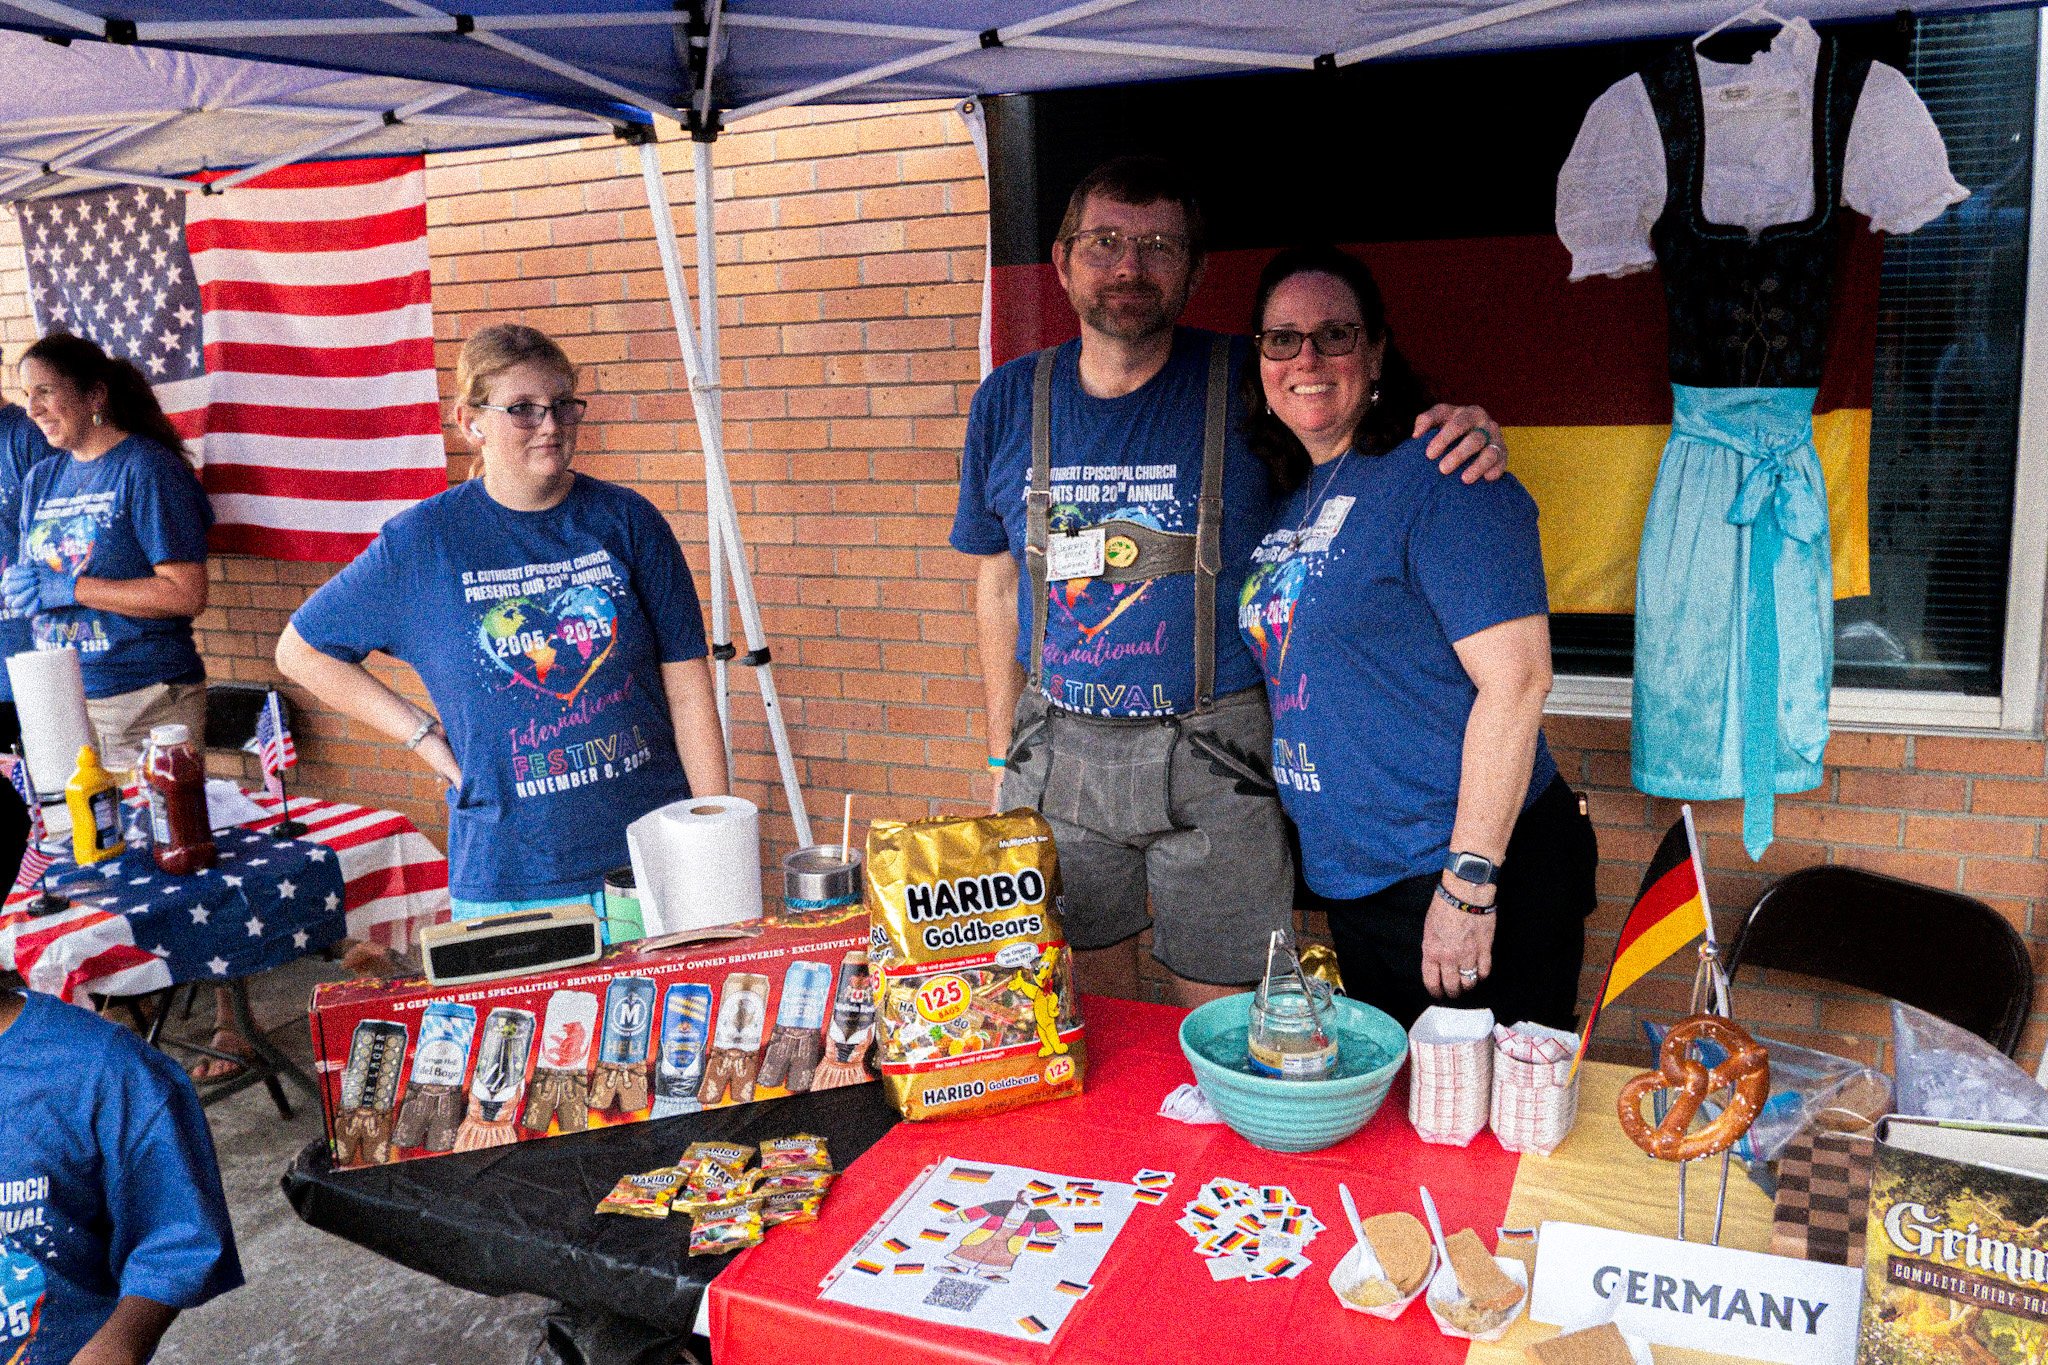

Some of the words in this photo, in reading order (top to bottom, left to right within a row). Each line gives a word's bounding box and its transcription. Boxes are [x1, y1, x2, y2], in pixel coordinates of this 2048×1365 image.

[1082, 465, 1134, 481] EPISCOPAL
[1135, 464, 1177, 479] CHURCH
[1075, 484, 1100, 502] OUR
[1127, 483, 1175, 501] ANNUAL
[461, 571, 477, 585] ST.
[478, 566, 524, 583] CUTHBERT
[524, 560, 574, 578] EPISCOPAL
[574, 550, 611, 570] CHURCH
[464, 584, 521, 603] PRESENTS
[521, 578, 547, 597] OUR
[570, 564, 615, 585] ANNUAL
[496, 629, 549, 658] 2005
[562, 618, 613, 646] 2025
[508, 672, 634, 755] International
[512, 725, 647, 780] FESTIVAL
[515, 768, 599, 798] NOVEMBER
[603, 763, 619, 780] 8,
[624, 748, 652, 774] 2025
[906, 869, 1044, 922] HARIBO
[925, 916, 1042, 949] Goldbears
[407, 995, 456, 1009] GERMAN
[458, 989, 486, 1003] BEER
[487, 979, 559, 999] SPECIALITIES
[566, 973, 612, 987] BREWED
[629, 962, 685, 978] PRIVATELY
[686, 957, 727, 971] OWNED
[728, 948, 785, 964] BREWERIES
[791, 937, 857, 955] EXCLUSIVELY
[921, 980, 963, 1011] 125
[938, 1006, 961, 1019] BAGS
[620, 1003, 642, 1025] M
[1048, 1060, 1071, 1079] 125
[924, 1081, 985, 1105] HARIBO
[988, 1074, 1039, 1091] Goldbears
[0, 1207, 45, 1234] UAL
[1592, 1265, 1829, 1335] GERMANY
[1894, 1263, 1967, 1295] COMPLETE
[1972, 1282, 2017, 1307] FAIRY
